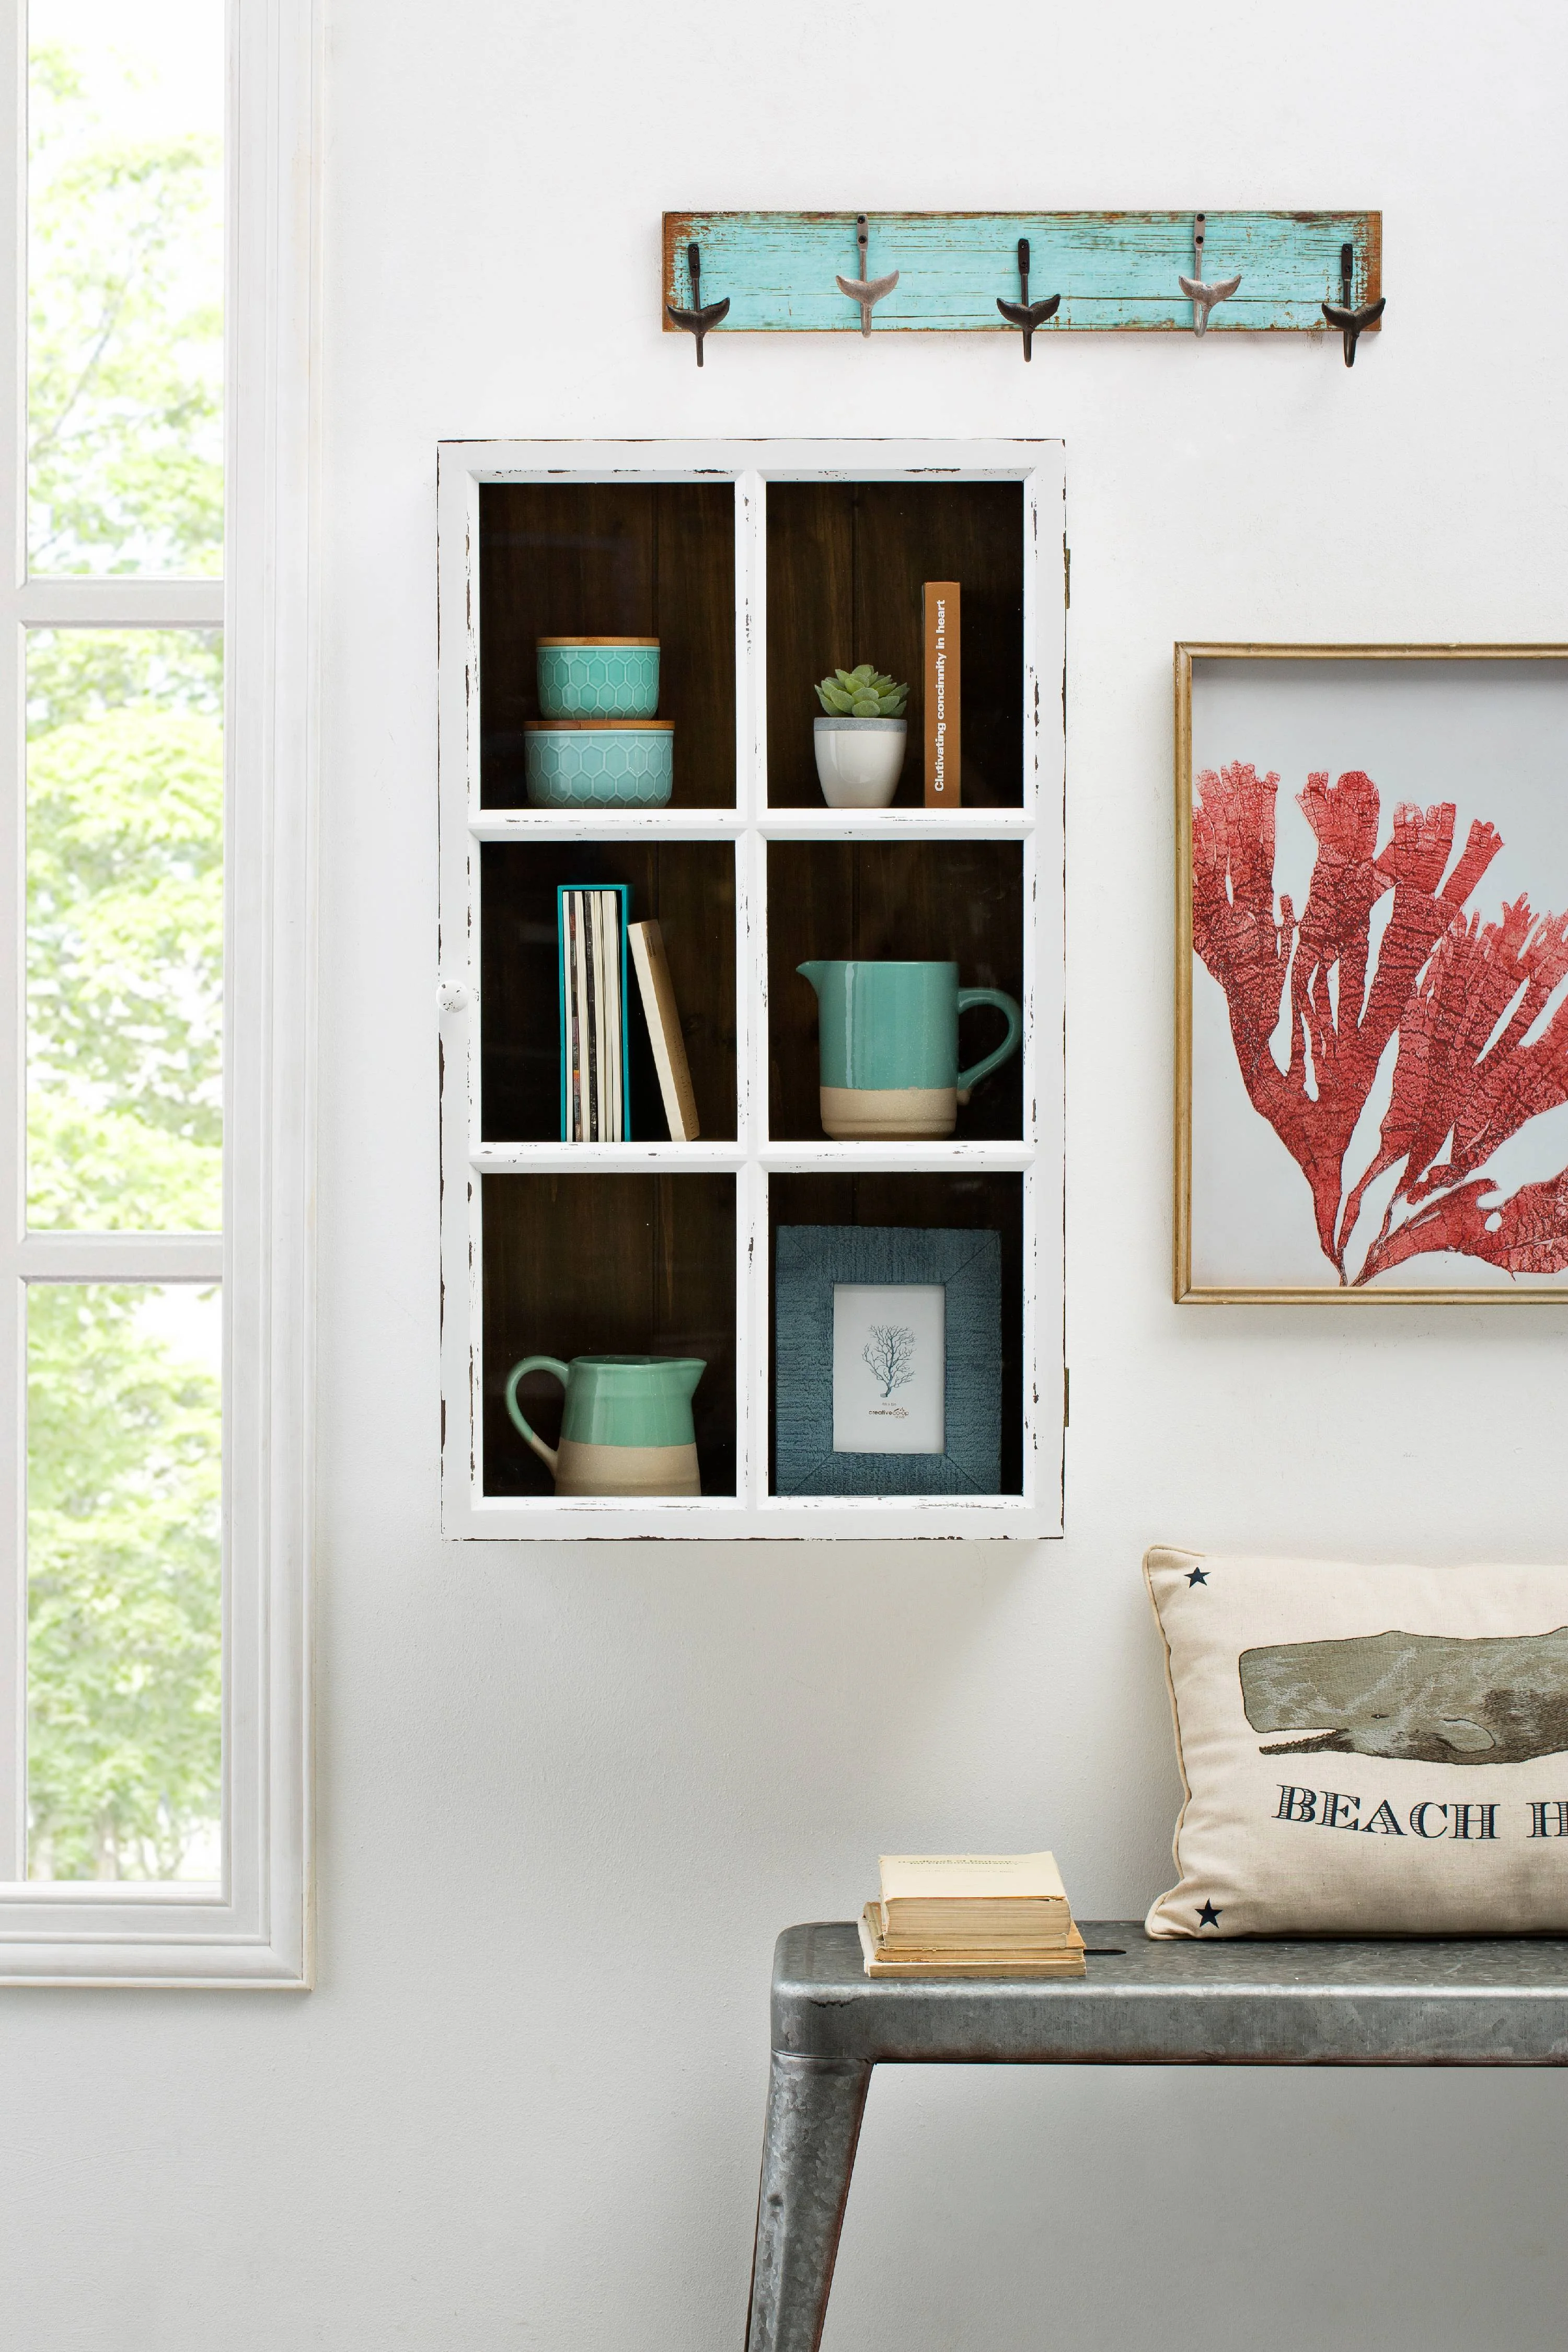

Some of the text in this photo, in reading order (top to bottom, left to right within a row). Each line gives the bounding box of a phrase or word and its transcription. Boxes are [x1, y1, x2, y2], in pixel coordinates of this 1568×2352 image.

[935, 599, 947, 791] Clutivating concinnity in heart
[1271, 1784, 1501, 1839] BEACH
